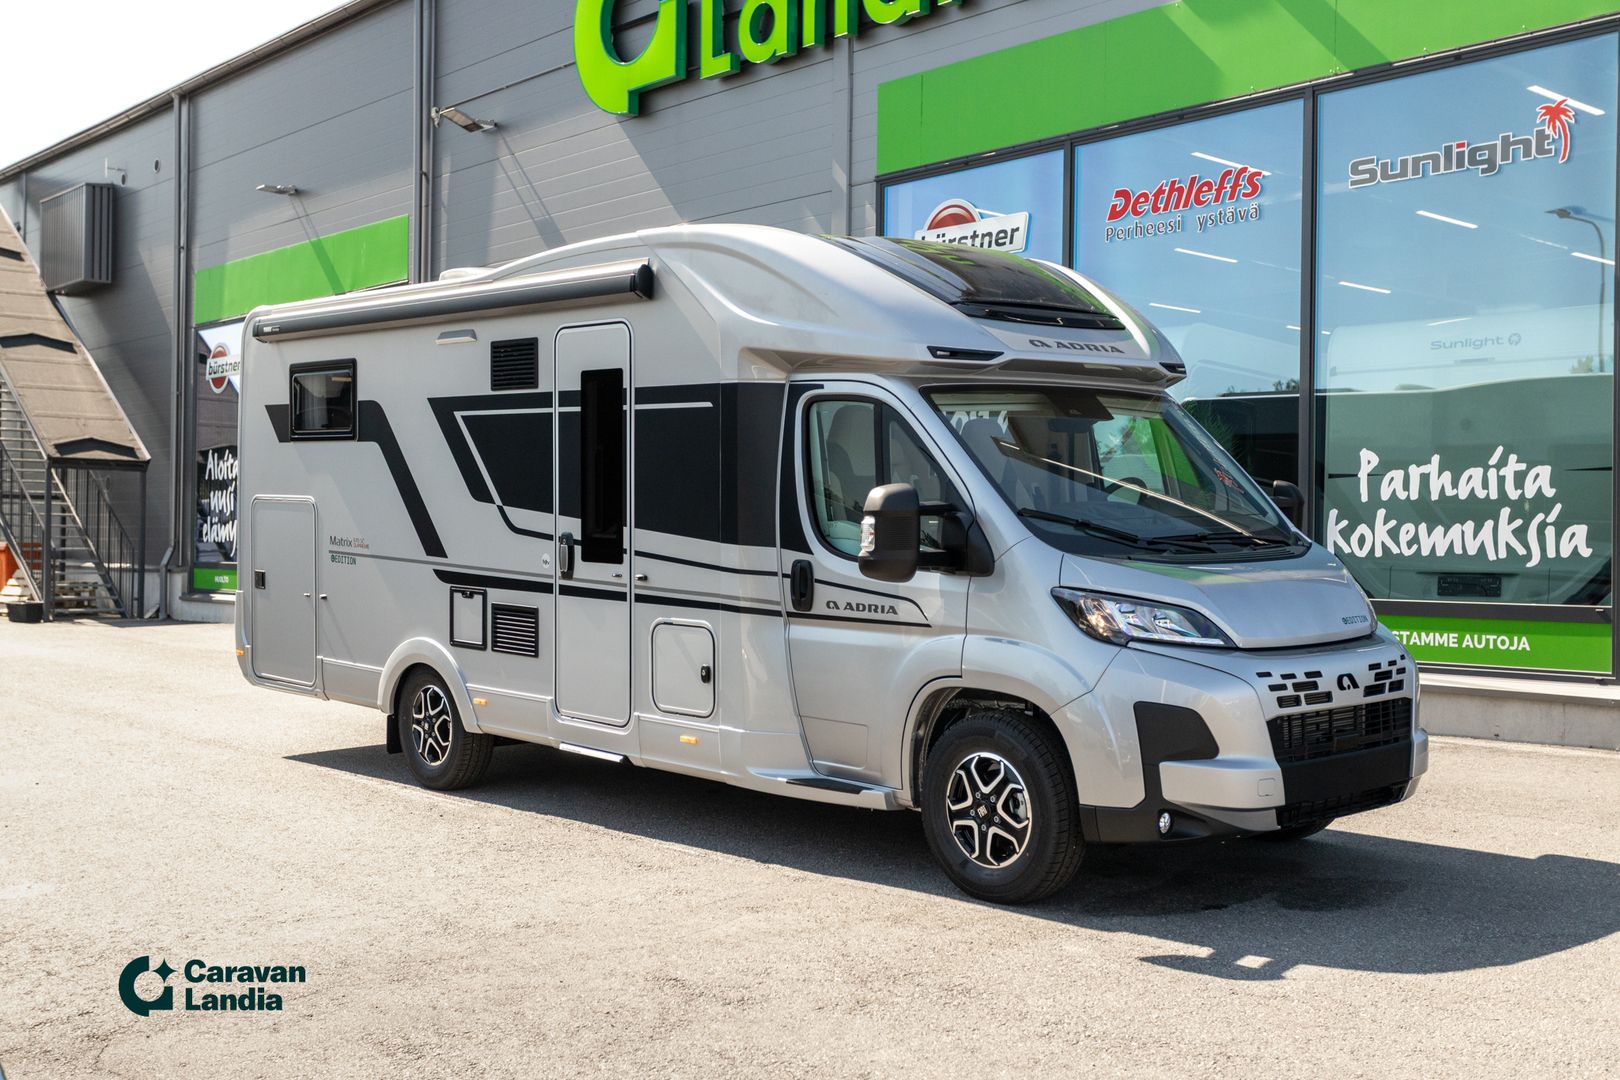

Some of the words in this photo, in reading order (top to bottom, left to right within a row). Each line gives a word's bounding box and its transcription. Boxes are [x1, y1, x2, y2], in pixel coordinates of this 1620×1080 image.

[1349, 126, 1555, 188] Sunlight
[1106, 166, 1263, 223] Dethleffs
[1105, 214, 1182, 242] Perheesi
[1196, 202, 1260, 232] ystävä
[1055, 341, 1125, 354] ADRIA
[1430, 336, 1504, 350] Sunlight
[330, 535, 352, 548] Matrix
[843, 601, 898, 615] ADRIA
[1462, 634, 1531, 651] AUTOJA
